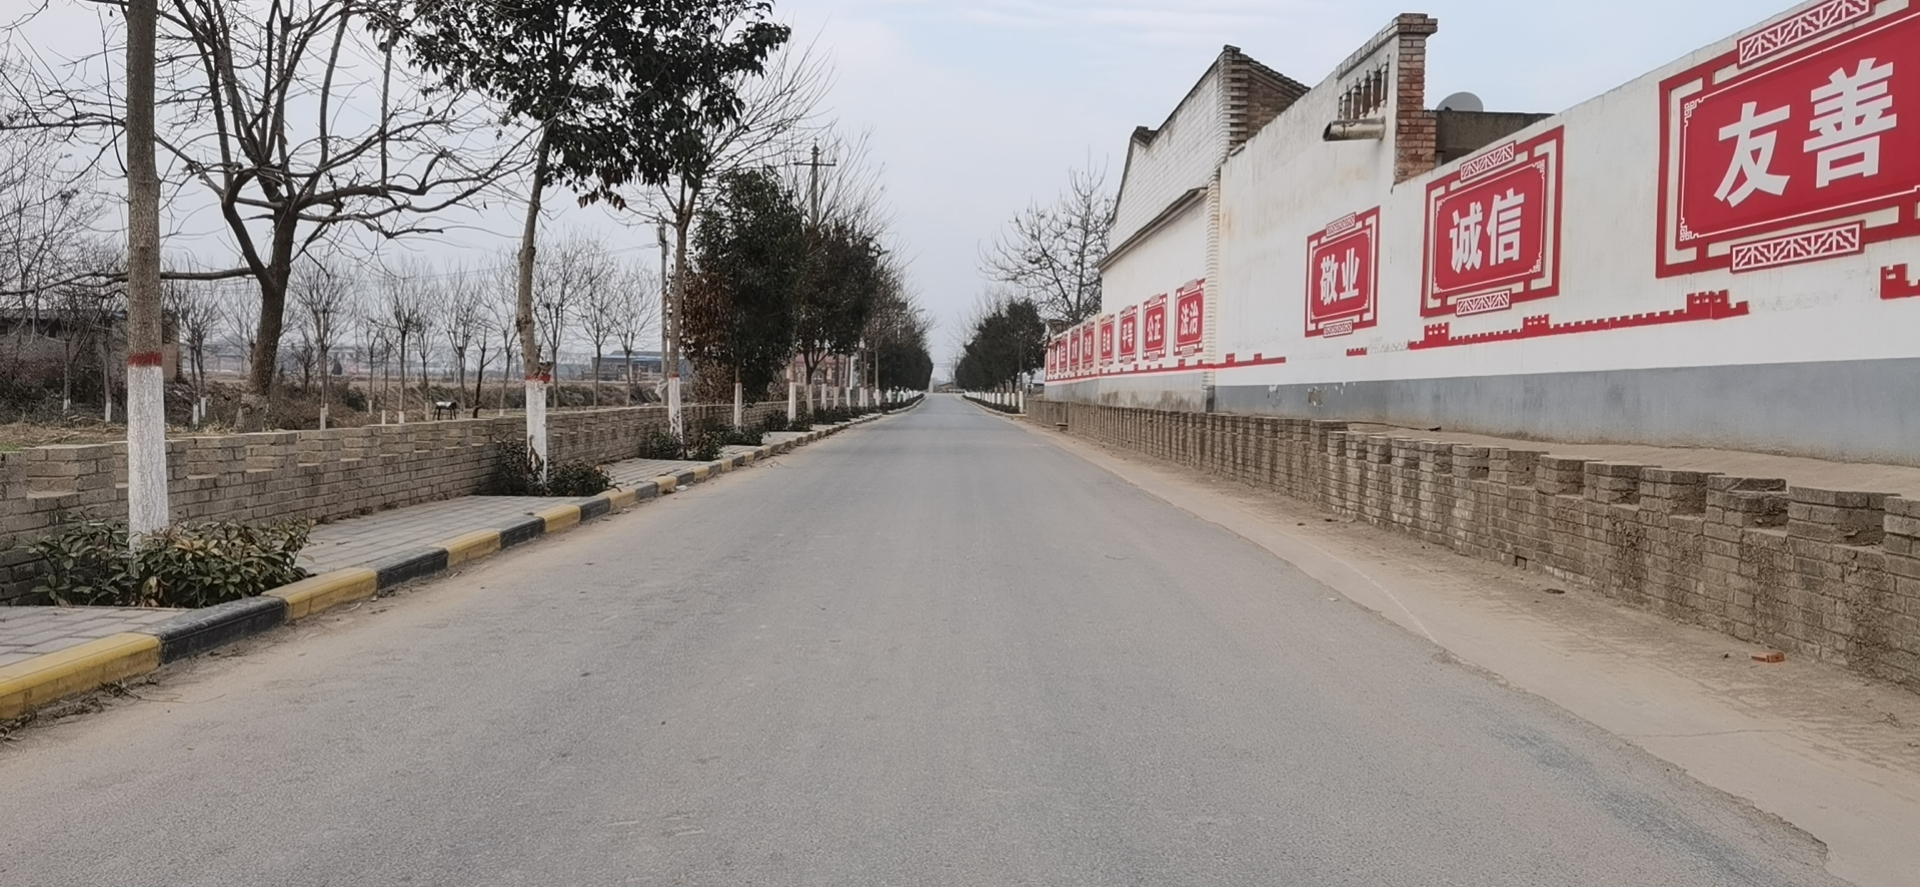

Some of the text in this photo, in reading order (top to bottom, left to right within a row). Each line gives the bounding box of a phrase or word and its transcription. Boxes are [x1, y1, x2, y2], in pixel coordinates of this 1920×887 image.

[1713, 57, 1897, 208] 友善
[1448, 188, 1526, 274] 诚信
[1320, 247, 1360, 306] 敬业
[1147, 314, 1162, 343] 公正
[1180, 300, 1199, 336] 法治
